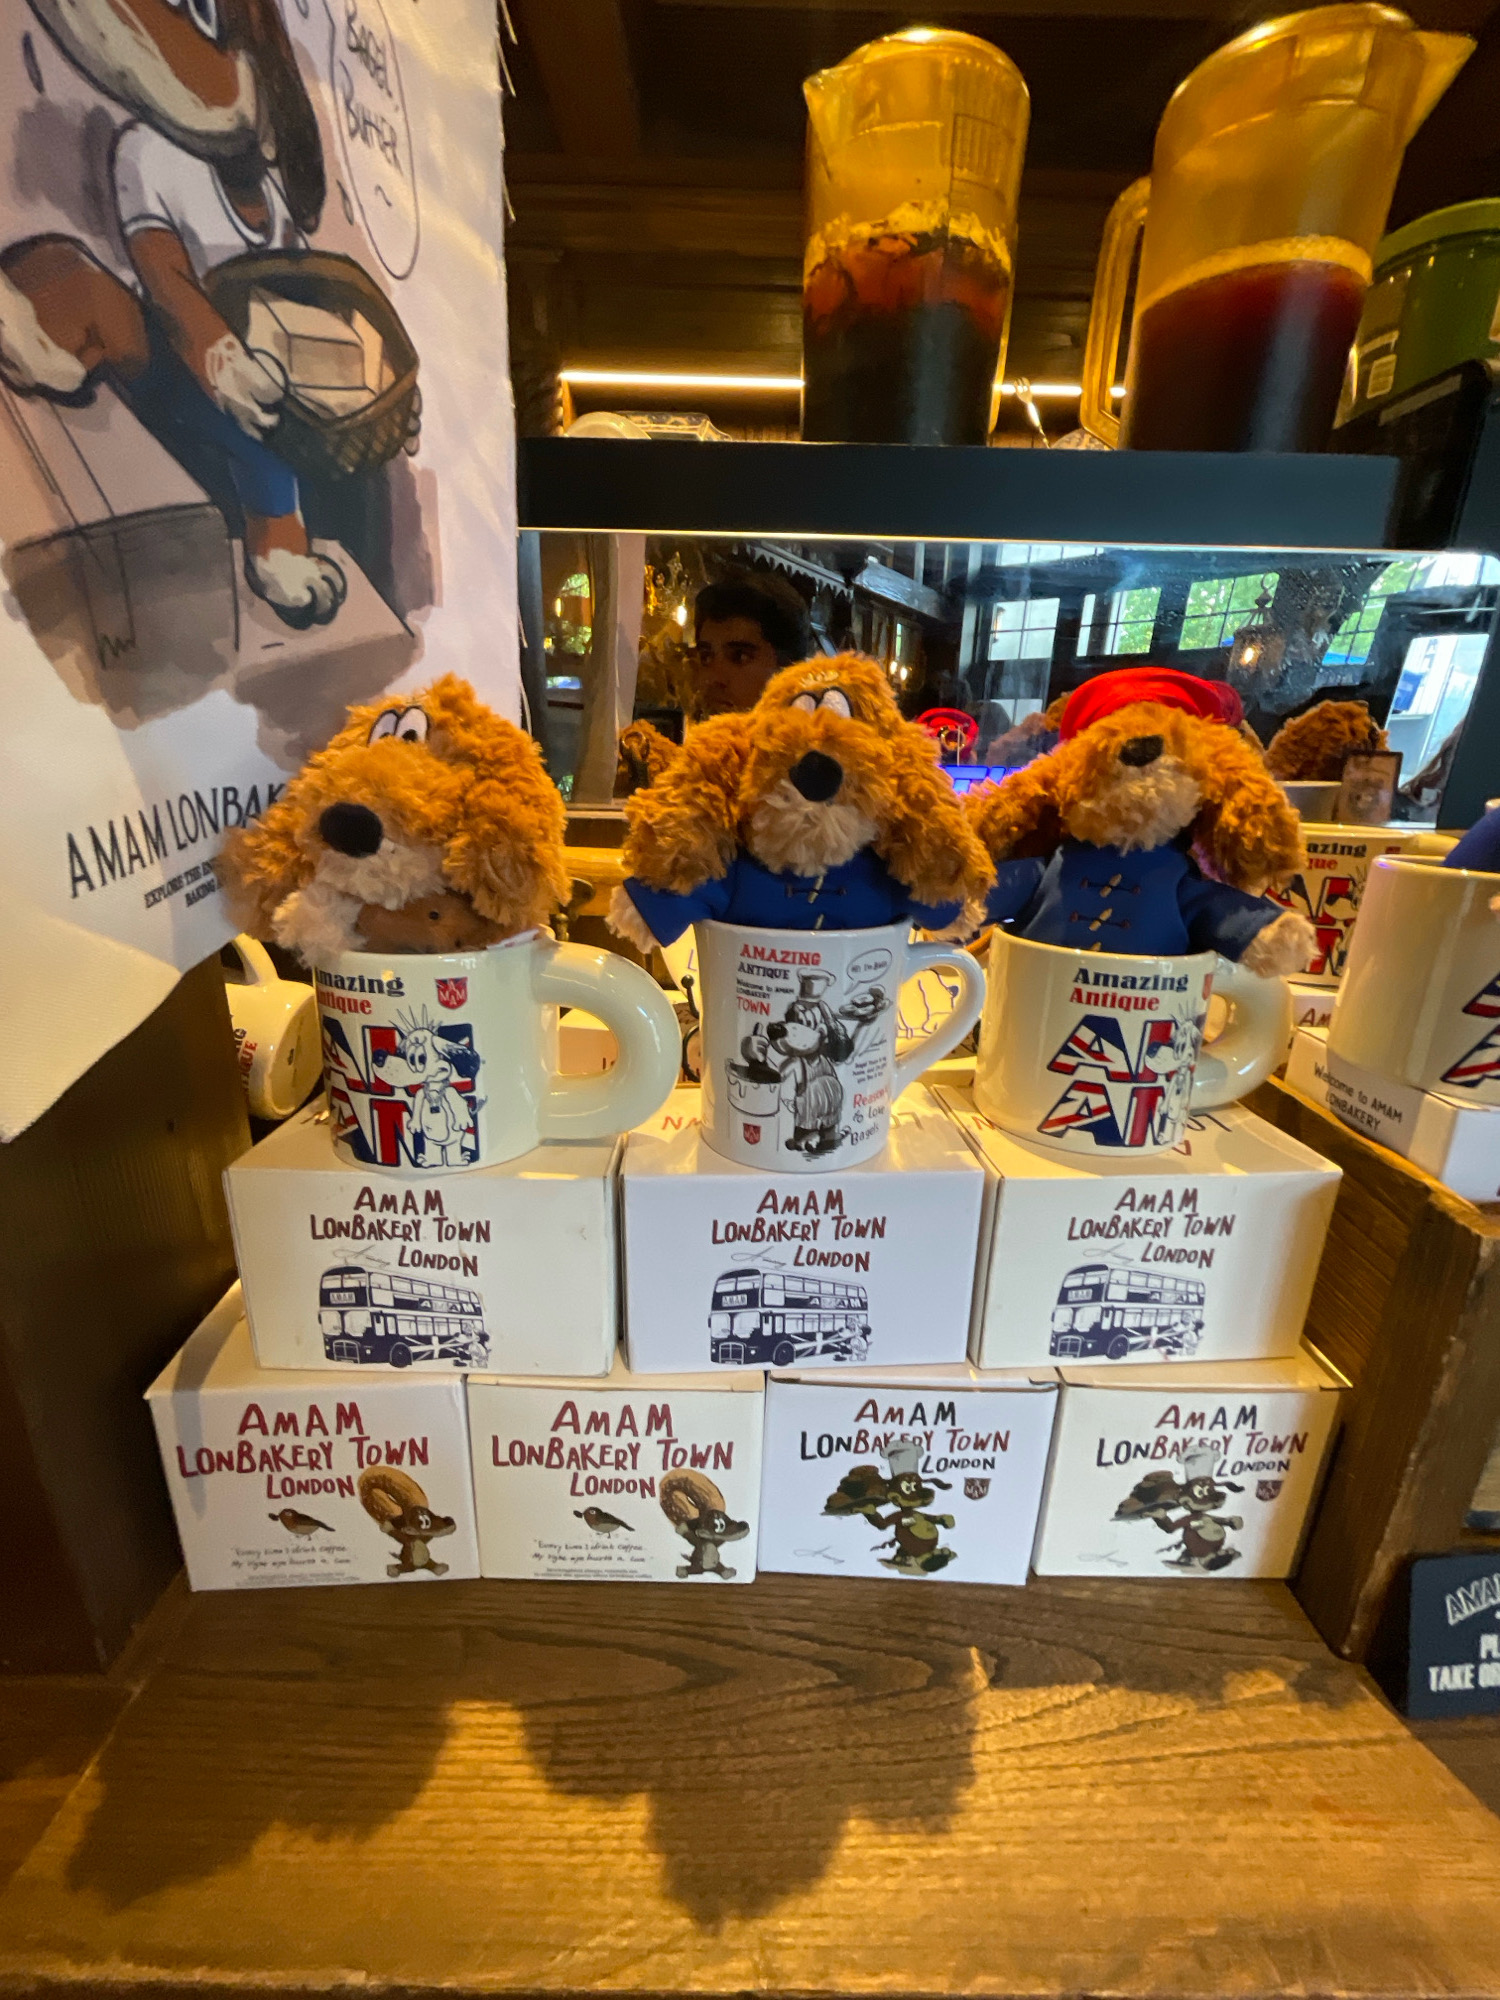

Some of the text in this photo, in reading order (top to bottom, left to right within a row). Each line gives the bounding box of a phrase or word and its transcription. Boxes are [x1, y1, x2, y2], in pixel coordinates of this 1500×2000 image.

[66, 803, 168, 899] AMAM
[1307, 842, 1367, 858] azing
[740, 944, 821, 966] AMAZING
[737, 961, 790, 980] ANTIQUE
[1072, 967, 1189, 993] Amazing
[737, 996, 770, 1016] TOWN
[1069, 987, 1160, 1012] Antique
[1314, 1062, 1402, 1124] Welcome to AMAM
[353, 1186, 444, 1216] AMAM
[756, 1189, 844, 1215] AMAM
[1114, 1187, 1198, 1213] AMAM
[310, 1214, 491, 1243] LONBAKERY TOWN
[712, 1214, 887, 1244] LONBAKERY TOWN
[1067, 1213, 1236, 1241] LONBAKERY TOWN
[398, 1245, 480, 1277] LONDON
[793, 1244, 871, 1272] LONDON
[1141, 1241, 1215, 1269] LONDON
[238, 1401, 365, 1437] AMAM
[551, 1400, 673, 1438] AMAM
[854, 1398, 956, 1426] AMAM
[1154, 1404, 1257, 1431] AMAM
[492, 1435, 734, 1470] LONBAKERY TOWN
[946, 1428, 1011, 1453] TOWN
[1246, 1431, 1309, 1456] TOWN
[176, 1436, 429, 1478] LONBAKERY TOWN
[921, 1455, 995, 1474] LONDON
[1216, 1459, 1290, 1478] LONDON
[266, 1475, 355, 1499] LONDON
[570, 1472, 656, 1499] LONDON
[1428, 1663, 1476, 1692] TAKE
